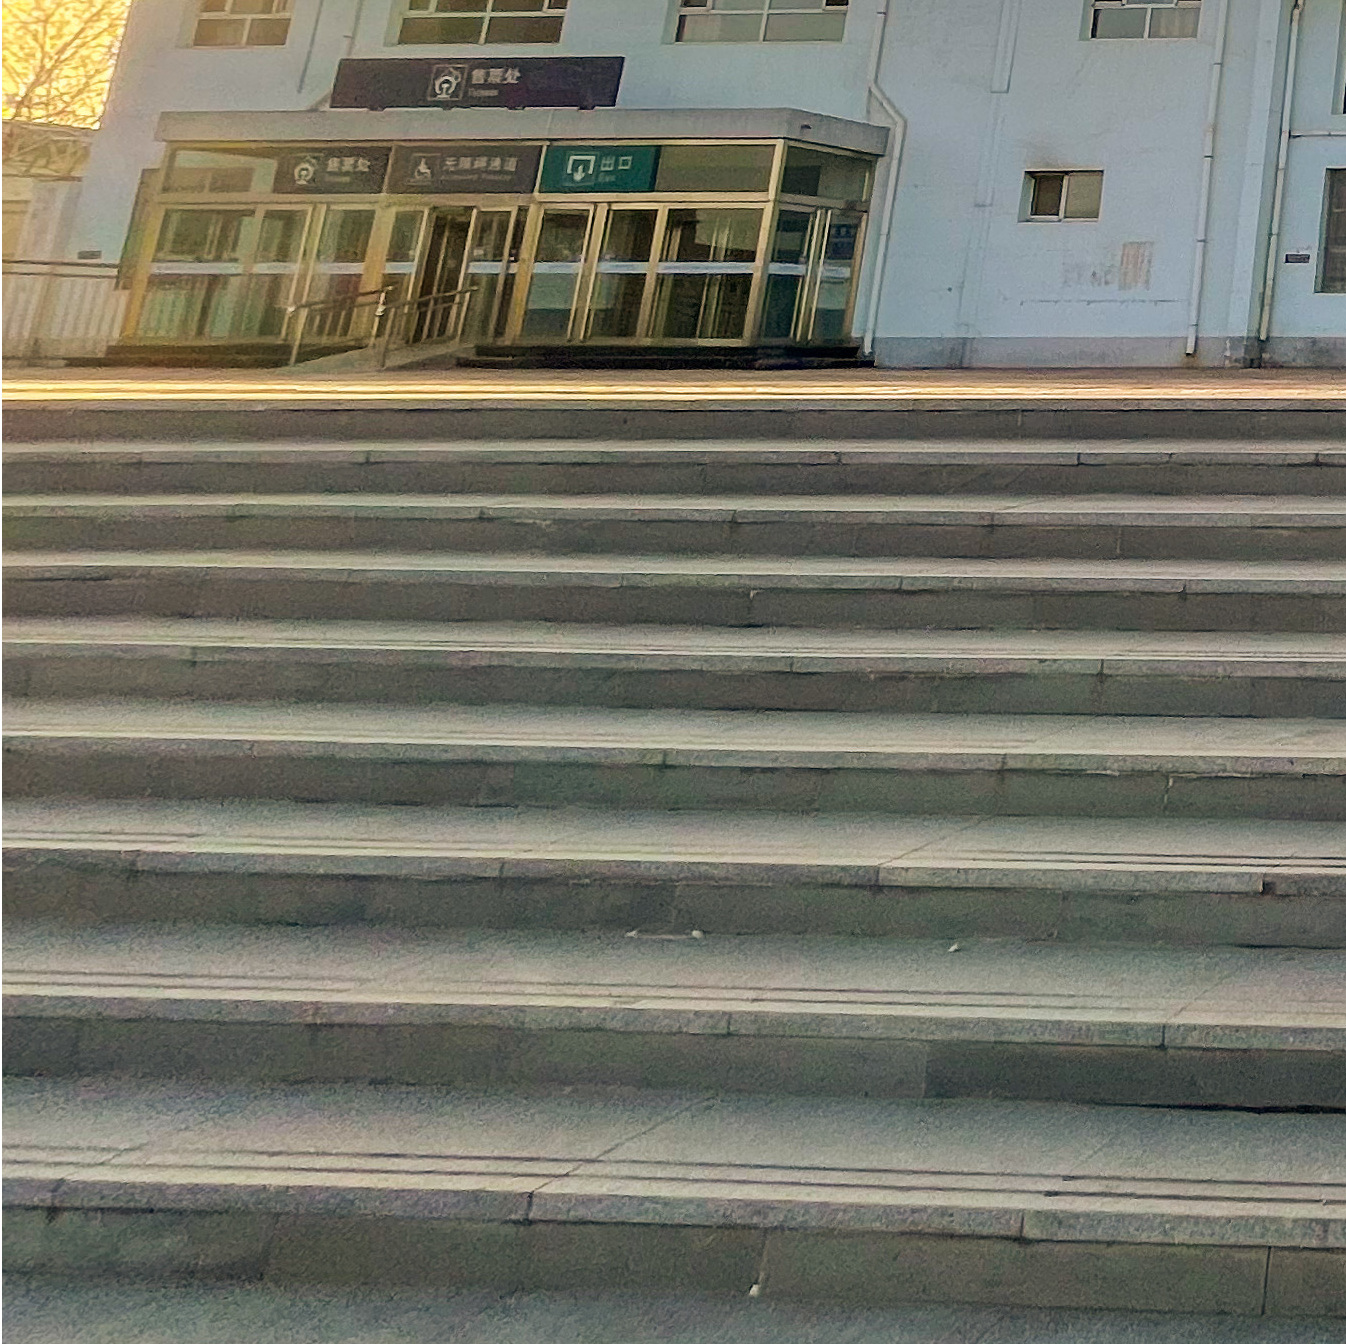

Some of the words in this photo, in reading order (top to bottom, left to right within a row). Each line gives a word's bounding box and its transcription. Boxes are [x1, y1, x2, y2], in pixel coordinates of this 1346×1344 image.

[471, 67, 521, 85] 售票处
[600, 156, 633, 171] 出口
